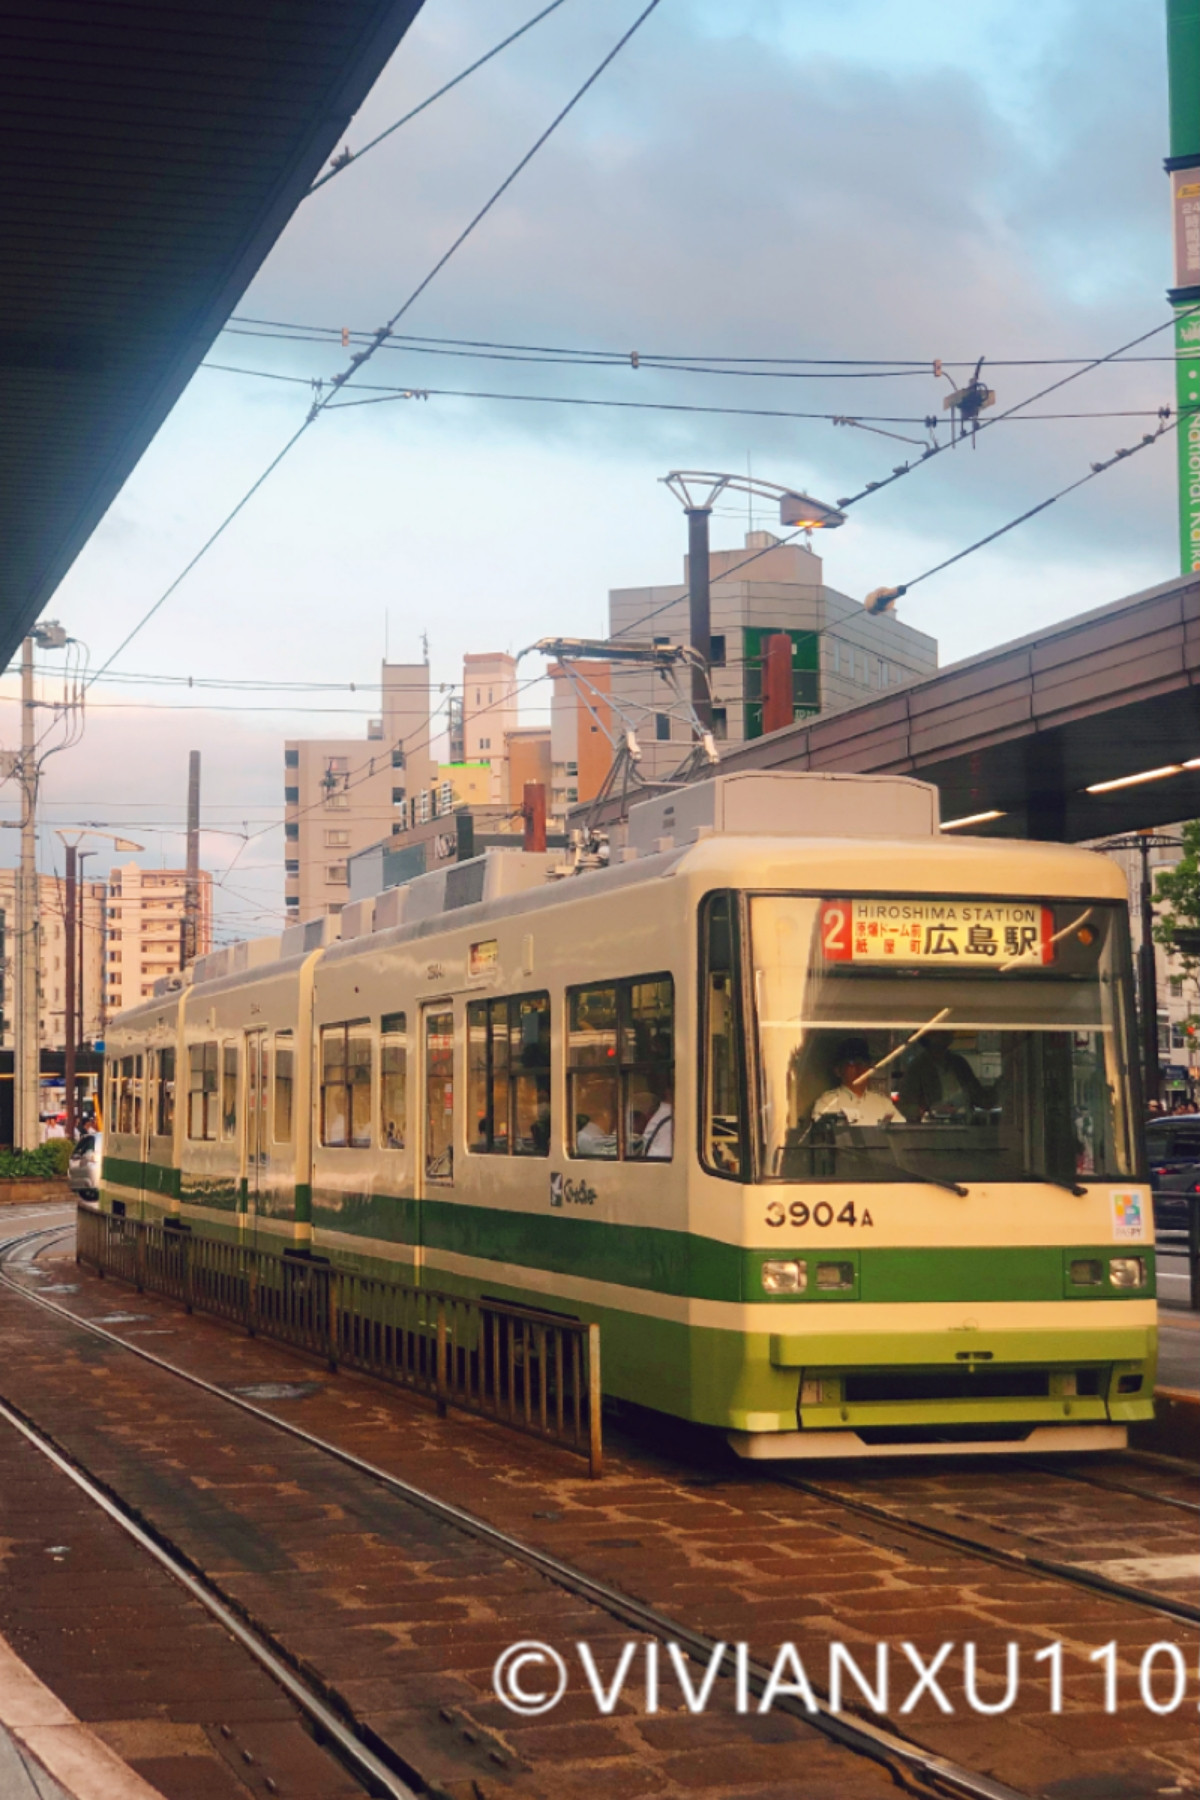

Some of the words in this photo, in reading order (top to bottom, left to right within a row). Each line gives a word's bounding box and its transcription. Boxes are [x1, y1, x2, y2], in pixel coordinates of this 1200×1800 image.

[823, 908, 845, 950] 2
[858, 905, 957, 920] HIROSHIMA
[962, 908, 1035, 922] STATION
[924, 923, 1038, 956] 広島駅
